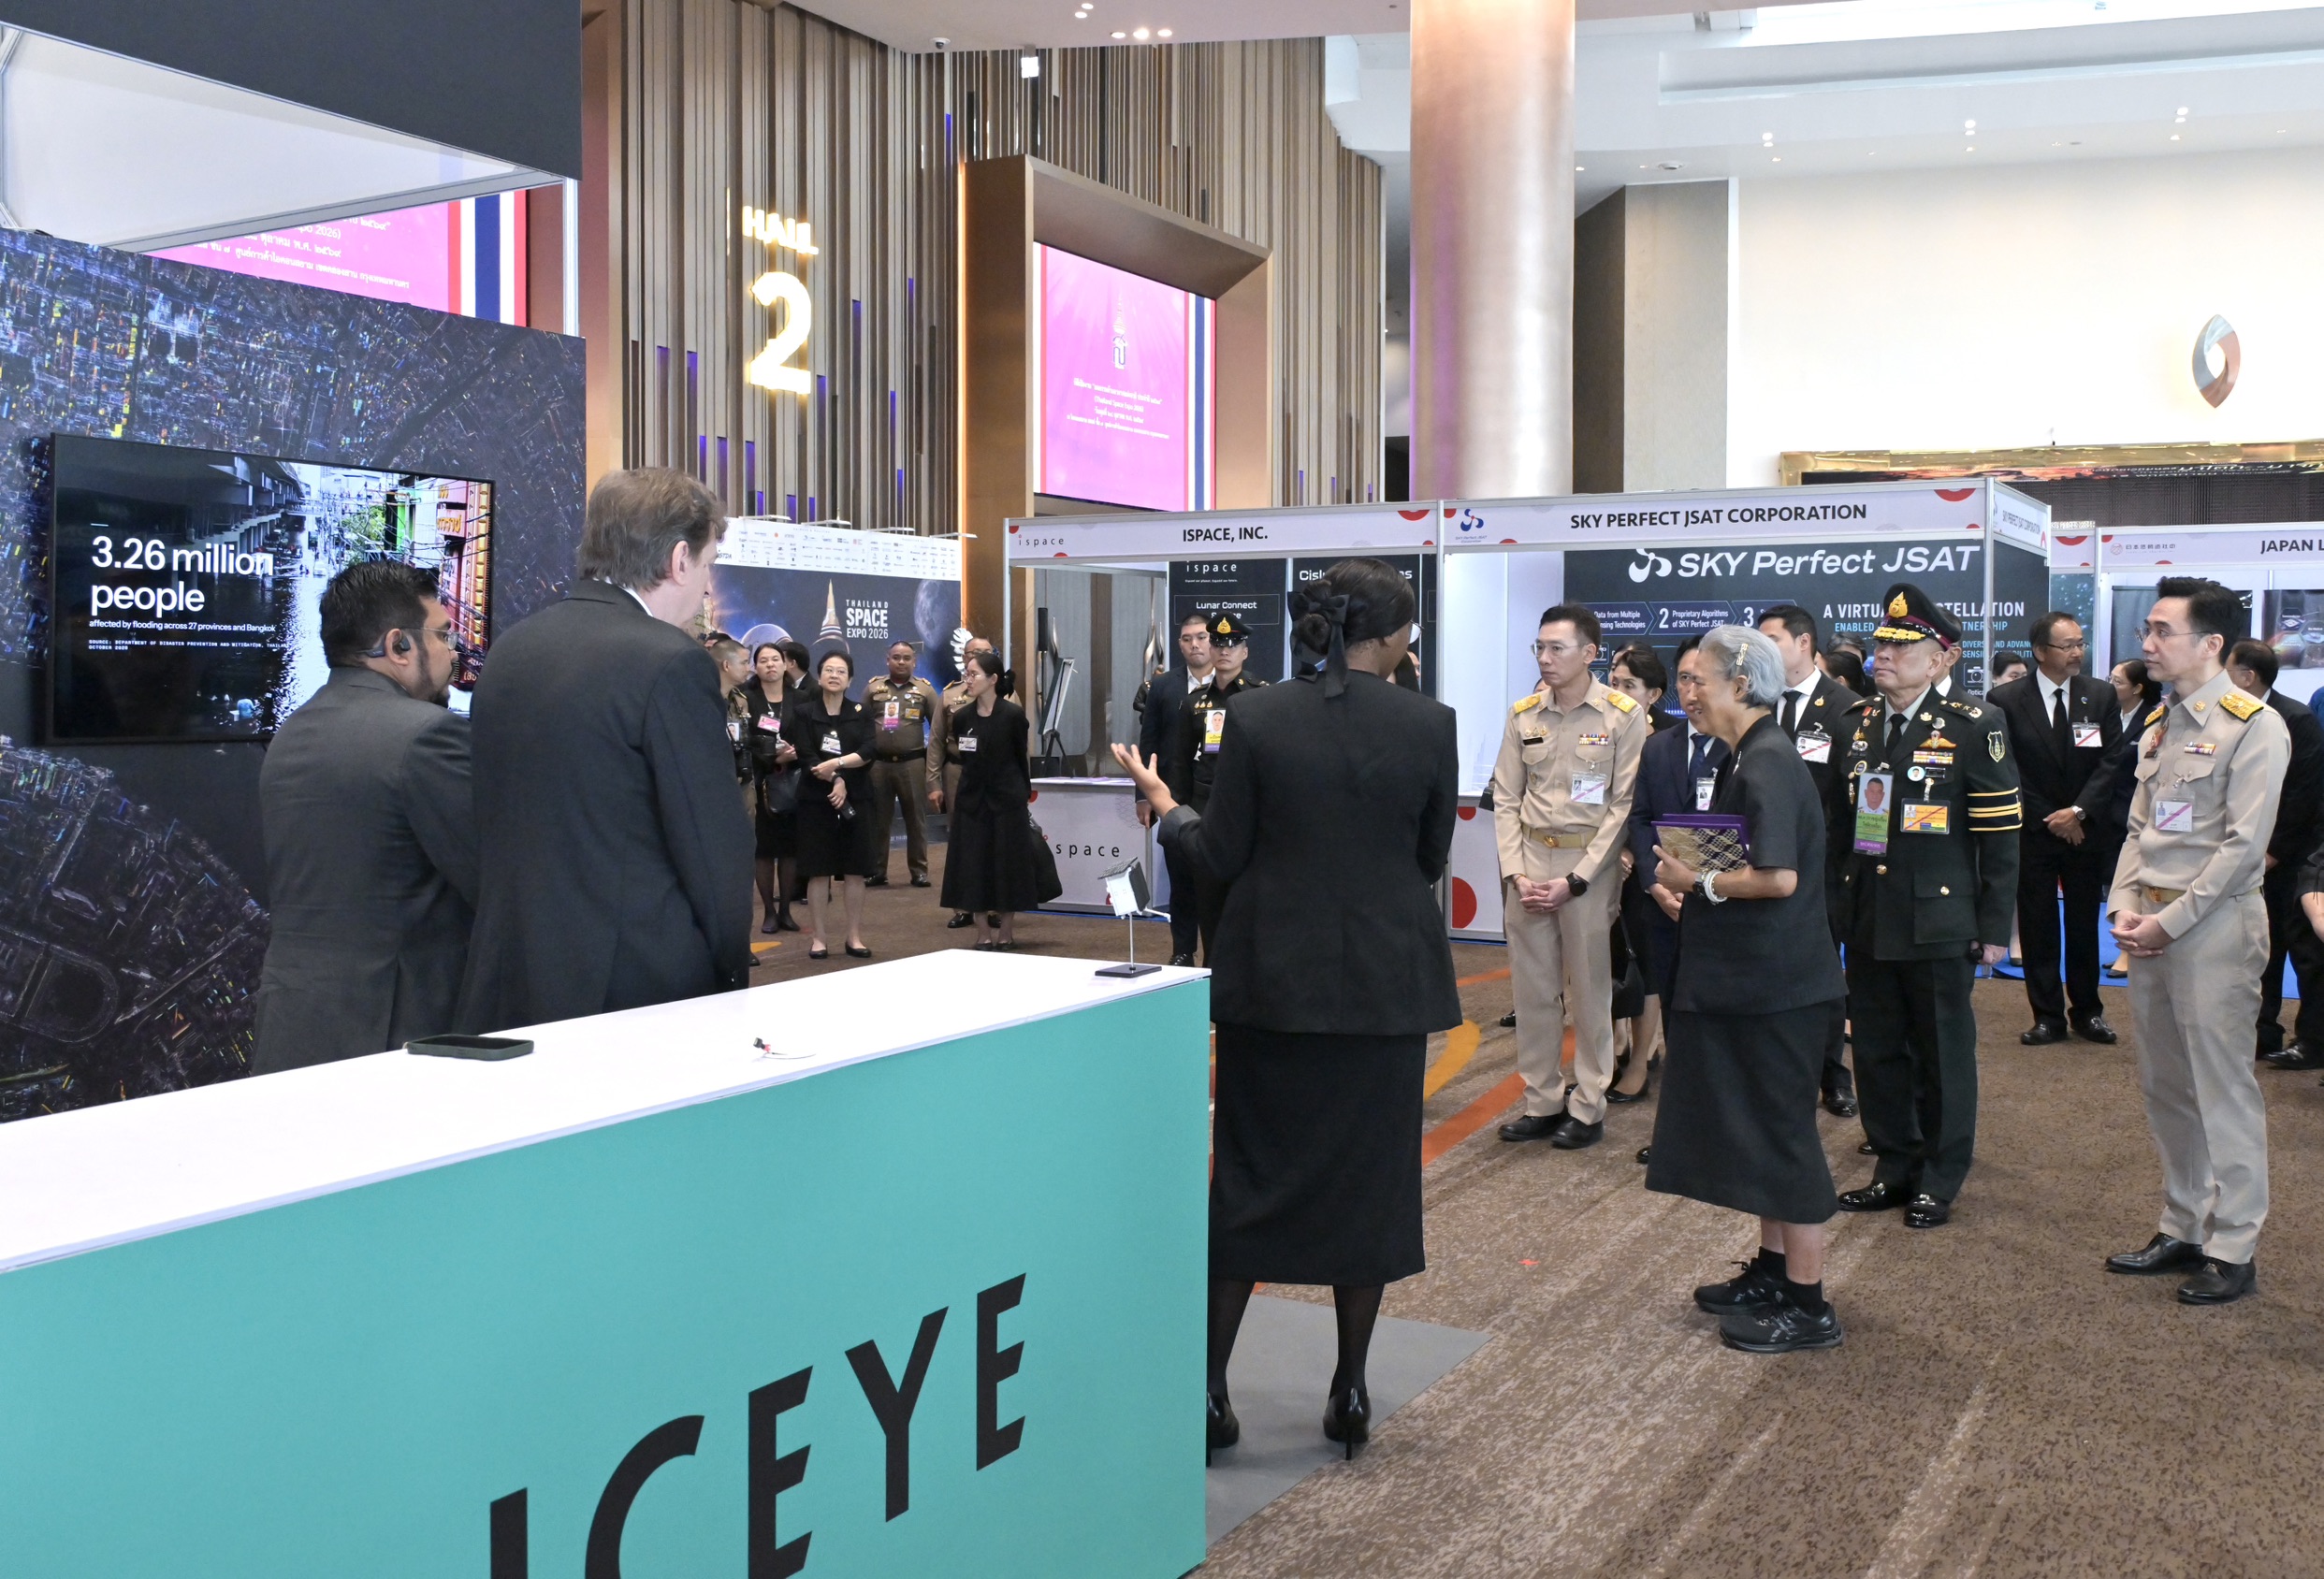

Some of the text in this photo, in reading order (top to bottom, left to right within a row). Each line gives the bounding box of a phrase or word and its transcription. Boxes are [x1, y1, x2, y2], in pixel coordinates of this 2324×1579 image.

[315, 225, 341, 239] 2026)
[749, 270, 812, 395] 2
[1571, 503, 1867, 529] SKY PERFECT JSAT CORPORATION
[1018, 534, 1064, 547] ispace
[1183, 526, 1269, 543] ISPACE, INC.
[2260, 539, 2313, 555] JAPAN
[92, 535, 274, 576] 3.26 million
[1678, 545, 1981, 577] SKY Perfect JSAT
[1186, 561, 1237, 574] ispace
[1300, 570, 1326, 581] Cisl
[91, 580, 205, 618] people
[846, 599, 889, 609] THAILAND
[1620, 611, 1640, 619] Multiple
[1672, 610, 1728, 619] Proprietary Algorithms
[1743, 607, 1754, 628] 3
[1823, 604, 1833, 618] A
[1837, 603, 1884, 618] VIRTU
[846, 608, 888, 628] SPACE
[1600, 620, 1646, 630] nsing Technologies
[1659, 608, 1669, 629] 2
[1691, 619, 1709, 628] Perfect
[1710, 619, 1724, 628] JSAT
[89, 619, 121, 629] affected
[123, 620, 132, 630] by
[132, 620, 163, 630] flooding
[197, 623, 231, 631] provinces
[246, 624, 276, 632] Bangkok
[1835, 622, 1874, 632] ENABLED
[847, 628, 889, 639] EXPO 2026
[1962, 640, 1983, 648] DIVERS
[1055, 843, 1120, 858] space
